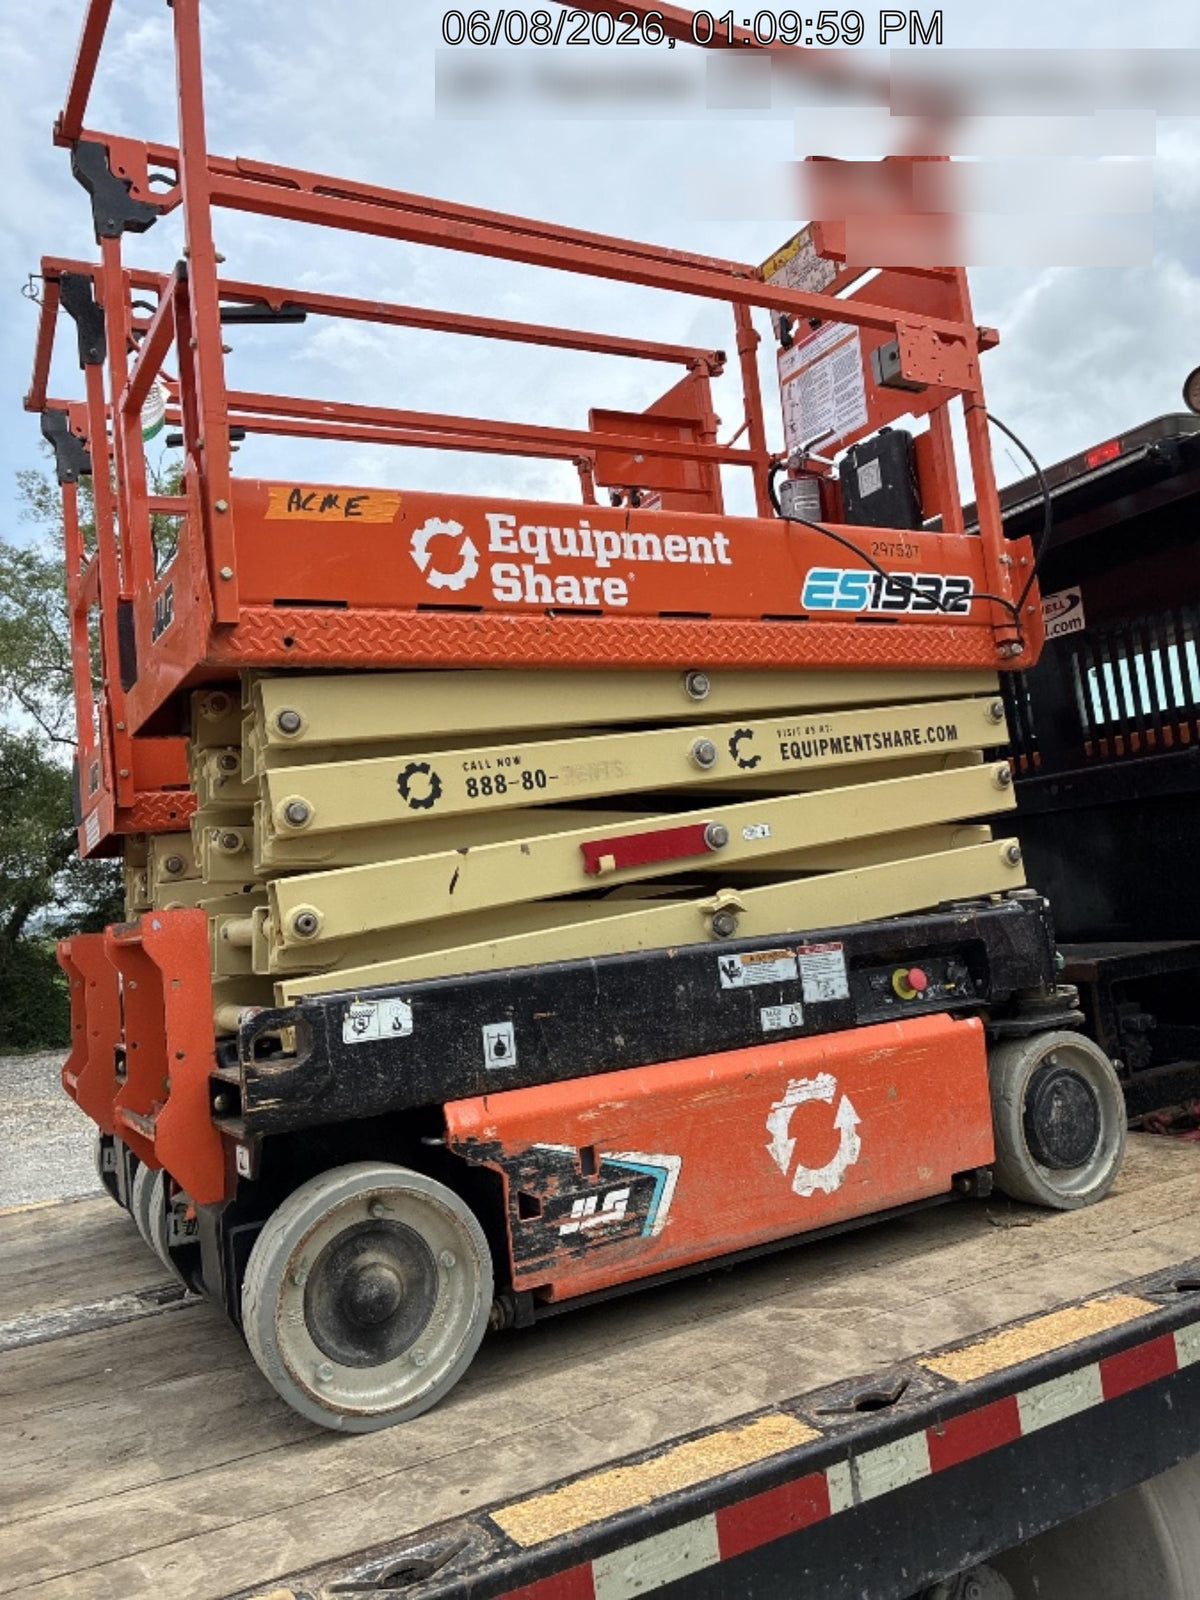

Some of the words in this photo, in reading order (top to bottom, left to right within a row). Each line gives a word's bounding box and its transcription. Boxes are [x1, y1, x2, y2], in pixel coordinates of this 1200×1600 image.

[287, 487, 370, 518] ACME
[485, 512, 733, 568] Equipment
[490, 562, 629, 607] Share
[803, 569, 973, 614] ES1932
[776, 726, 801, 738] VISIT
[780, 724, 959, 761] EQUIPMENTSHARE.COM
[462, 761, 492, 772] CALL
[496, 756, 521, 768] NOW
[558, 1187, 631, 1236] JLG
